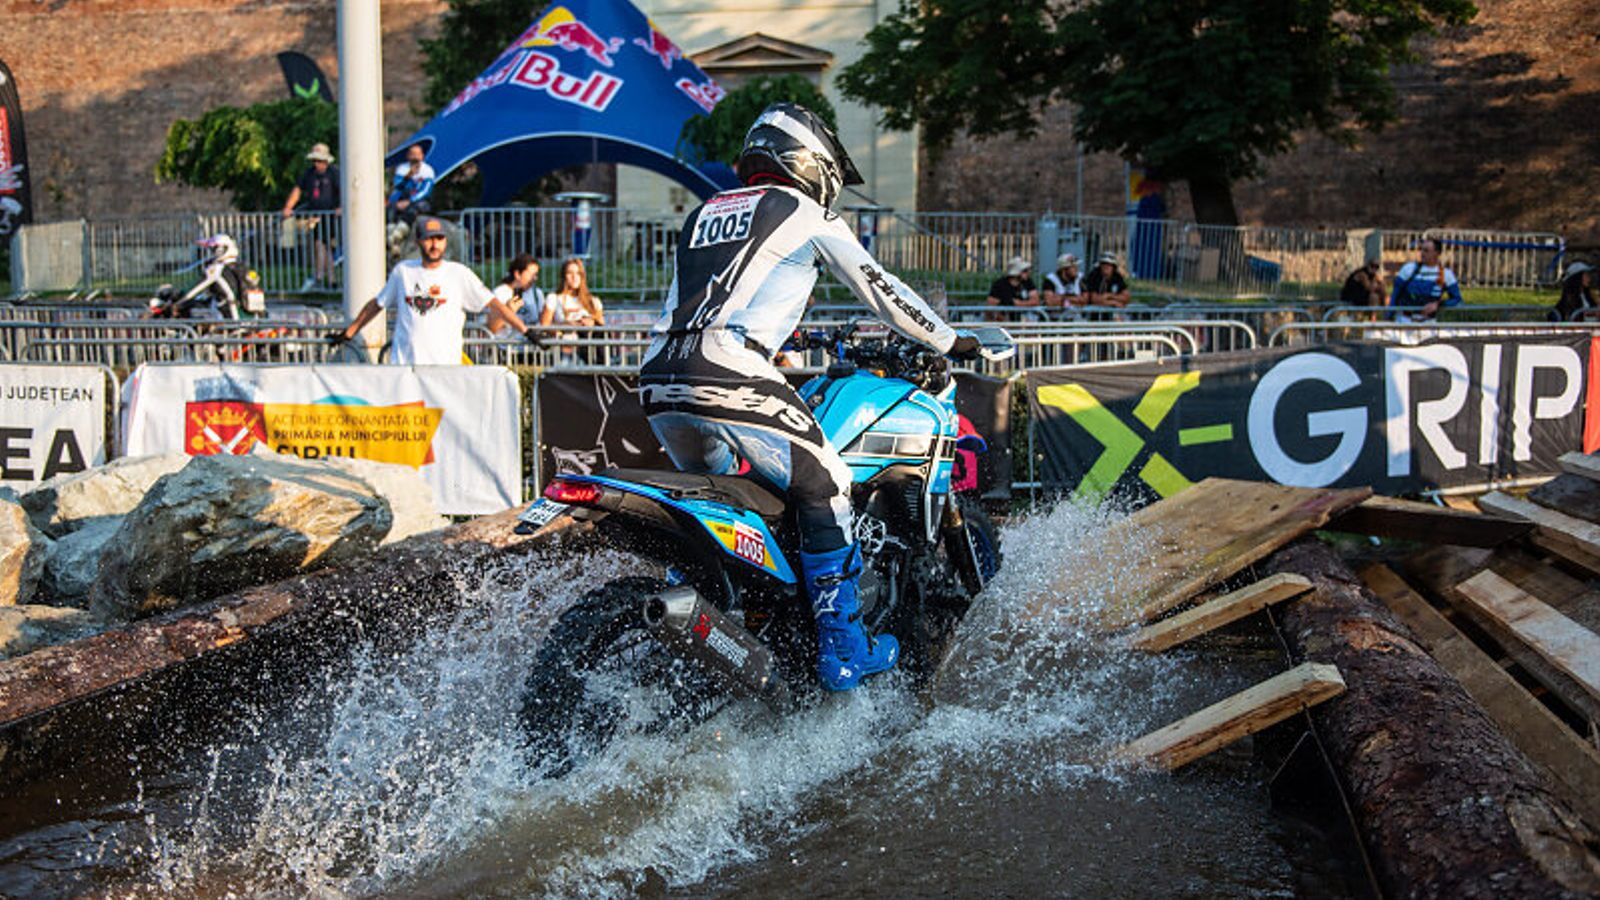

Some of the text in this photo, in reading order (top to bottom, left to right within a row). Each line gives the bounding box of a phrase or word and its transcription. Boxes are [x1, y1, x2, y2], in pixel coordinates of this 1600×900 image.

[512, 52, 621, 110] Bull
[695, 211, 752, 246] 1005
[860, 264, 936, 332] alpinestars
[414, 414, 430, 427] DE
[1037, 344, 1582, 500] X-GRIP
[735, 534, 764, 564] 1005
